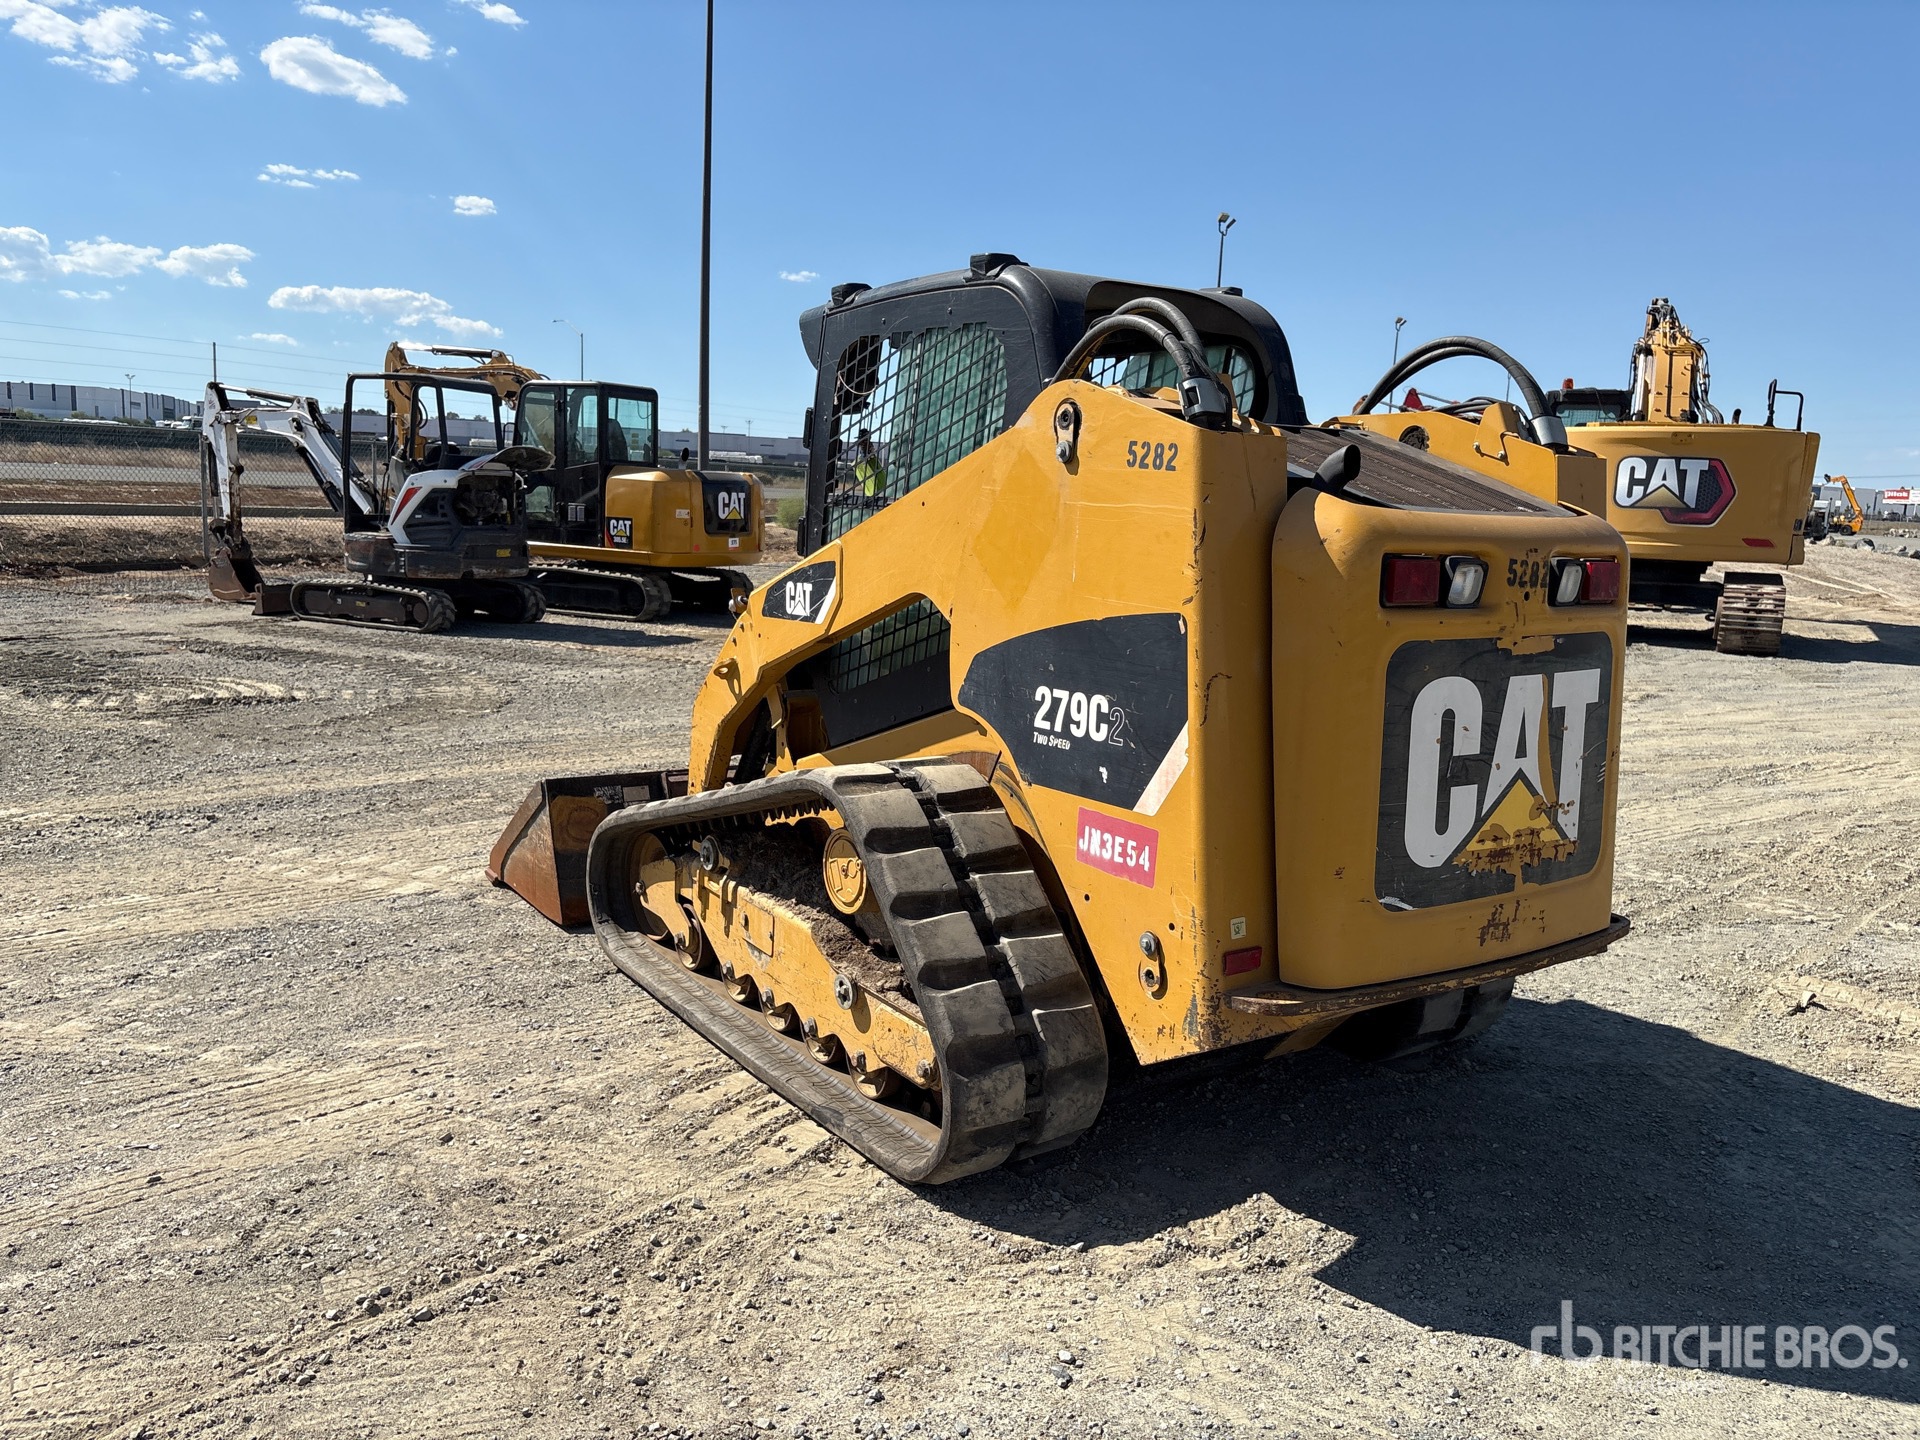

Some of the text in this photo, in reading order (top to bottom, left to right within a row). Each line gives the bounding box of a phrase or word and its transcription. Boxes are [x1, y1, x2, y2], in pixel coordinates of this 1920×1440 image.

[1127, 440, 1179, 471] 5282
[1615, 457, 1709, 508] CAT
[718, 491, 745, 519] CAT
[610, 519, 631, 536] CAT
[786, 581, 813, 616] CAT
[1404, 668, 1601, 868] CAT
